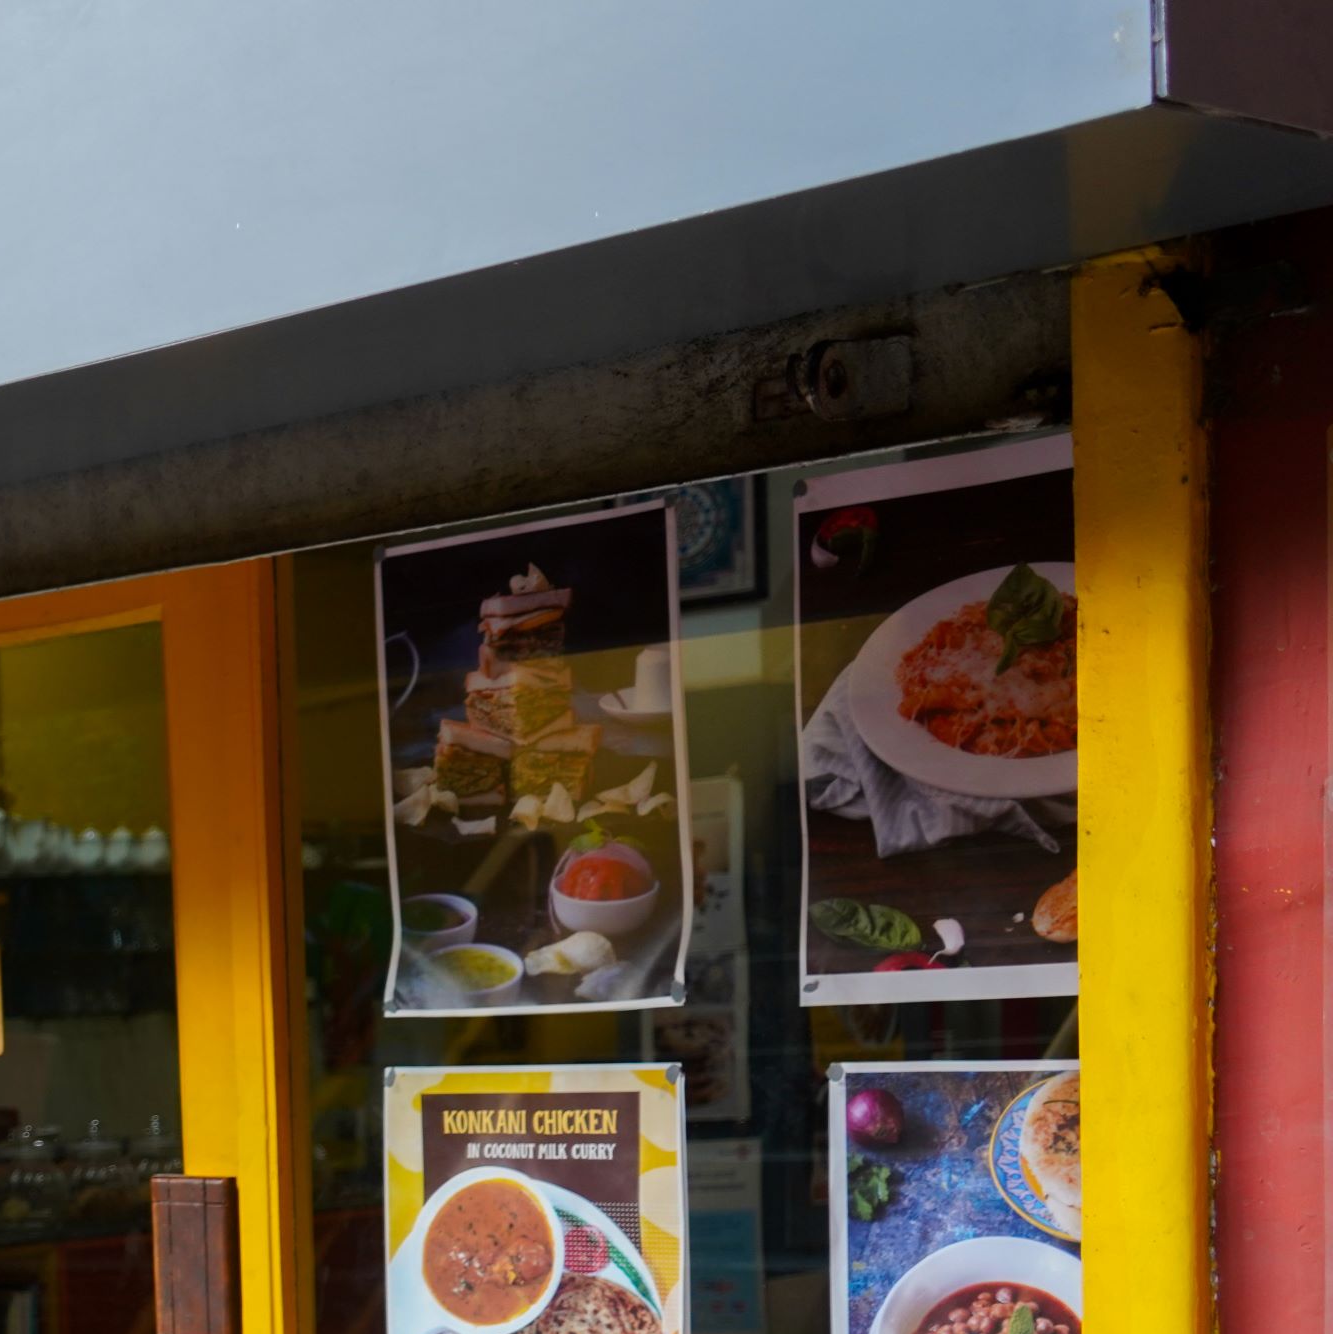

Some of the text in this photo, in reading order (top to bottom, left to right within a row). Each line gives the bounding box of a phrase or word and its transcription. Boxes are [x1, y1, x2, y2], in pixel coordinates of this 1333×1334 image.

[443, 1109, 618, 1135] KONKANI CHICKEN
[467, 1142, 617, 1160] IN COCONUT MILK CURRY
